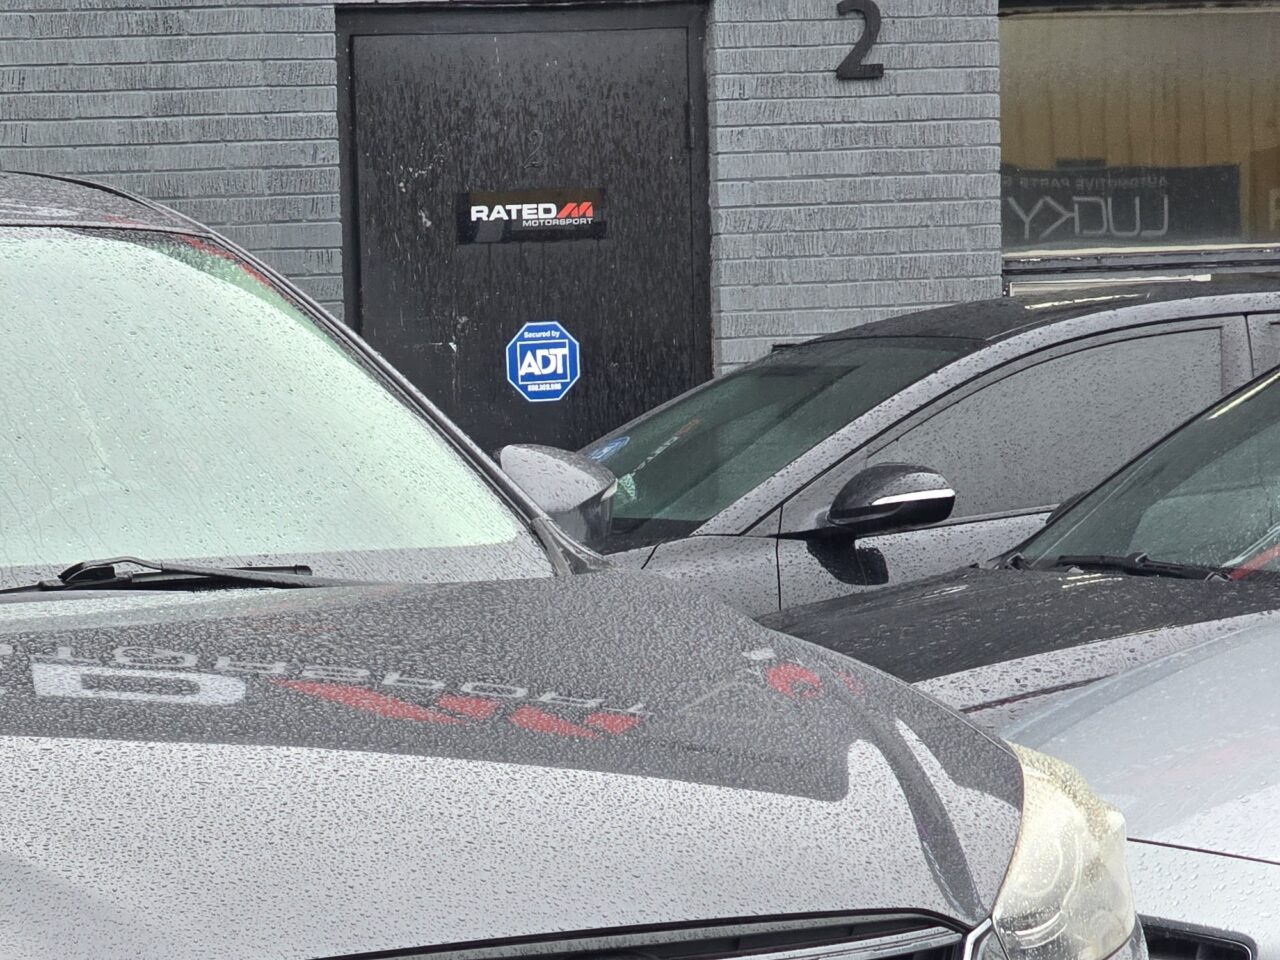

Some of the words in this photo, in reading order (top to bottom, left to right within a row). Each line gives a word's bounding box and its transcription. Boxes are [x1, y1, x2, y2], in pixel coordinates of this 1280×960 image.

[835, 0, 884, 81] 2
[470, 203, 558, 222] RATED
[522, 217, 594, 227] MOTORSPORT
[523, 331, 550, 339] Secured
[552, 330, 560, 338] by
[520, 347, 567, 376] ADT
